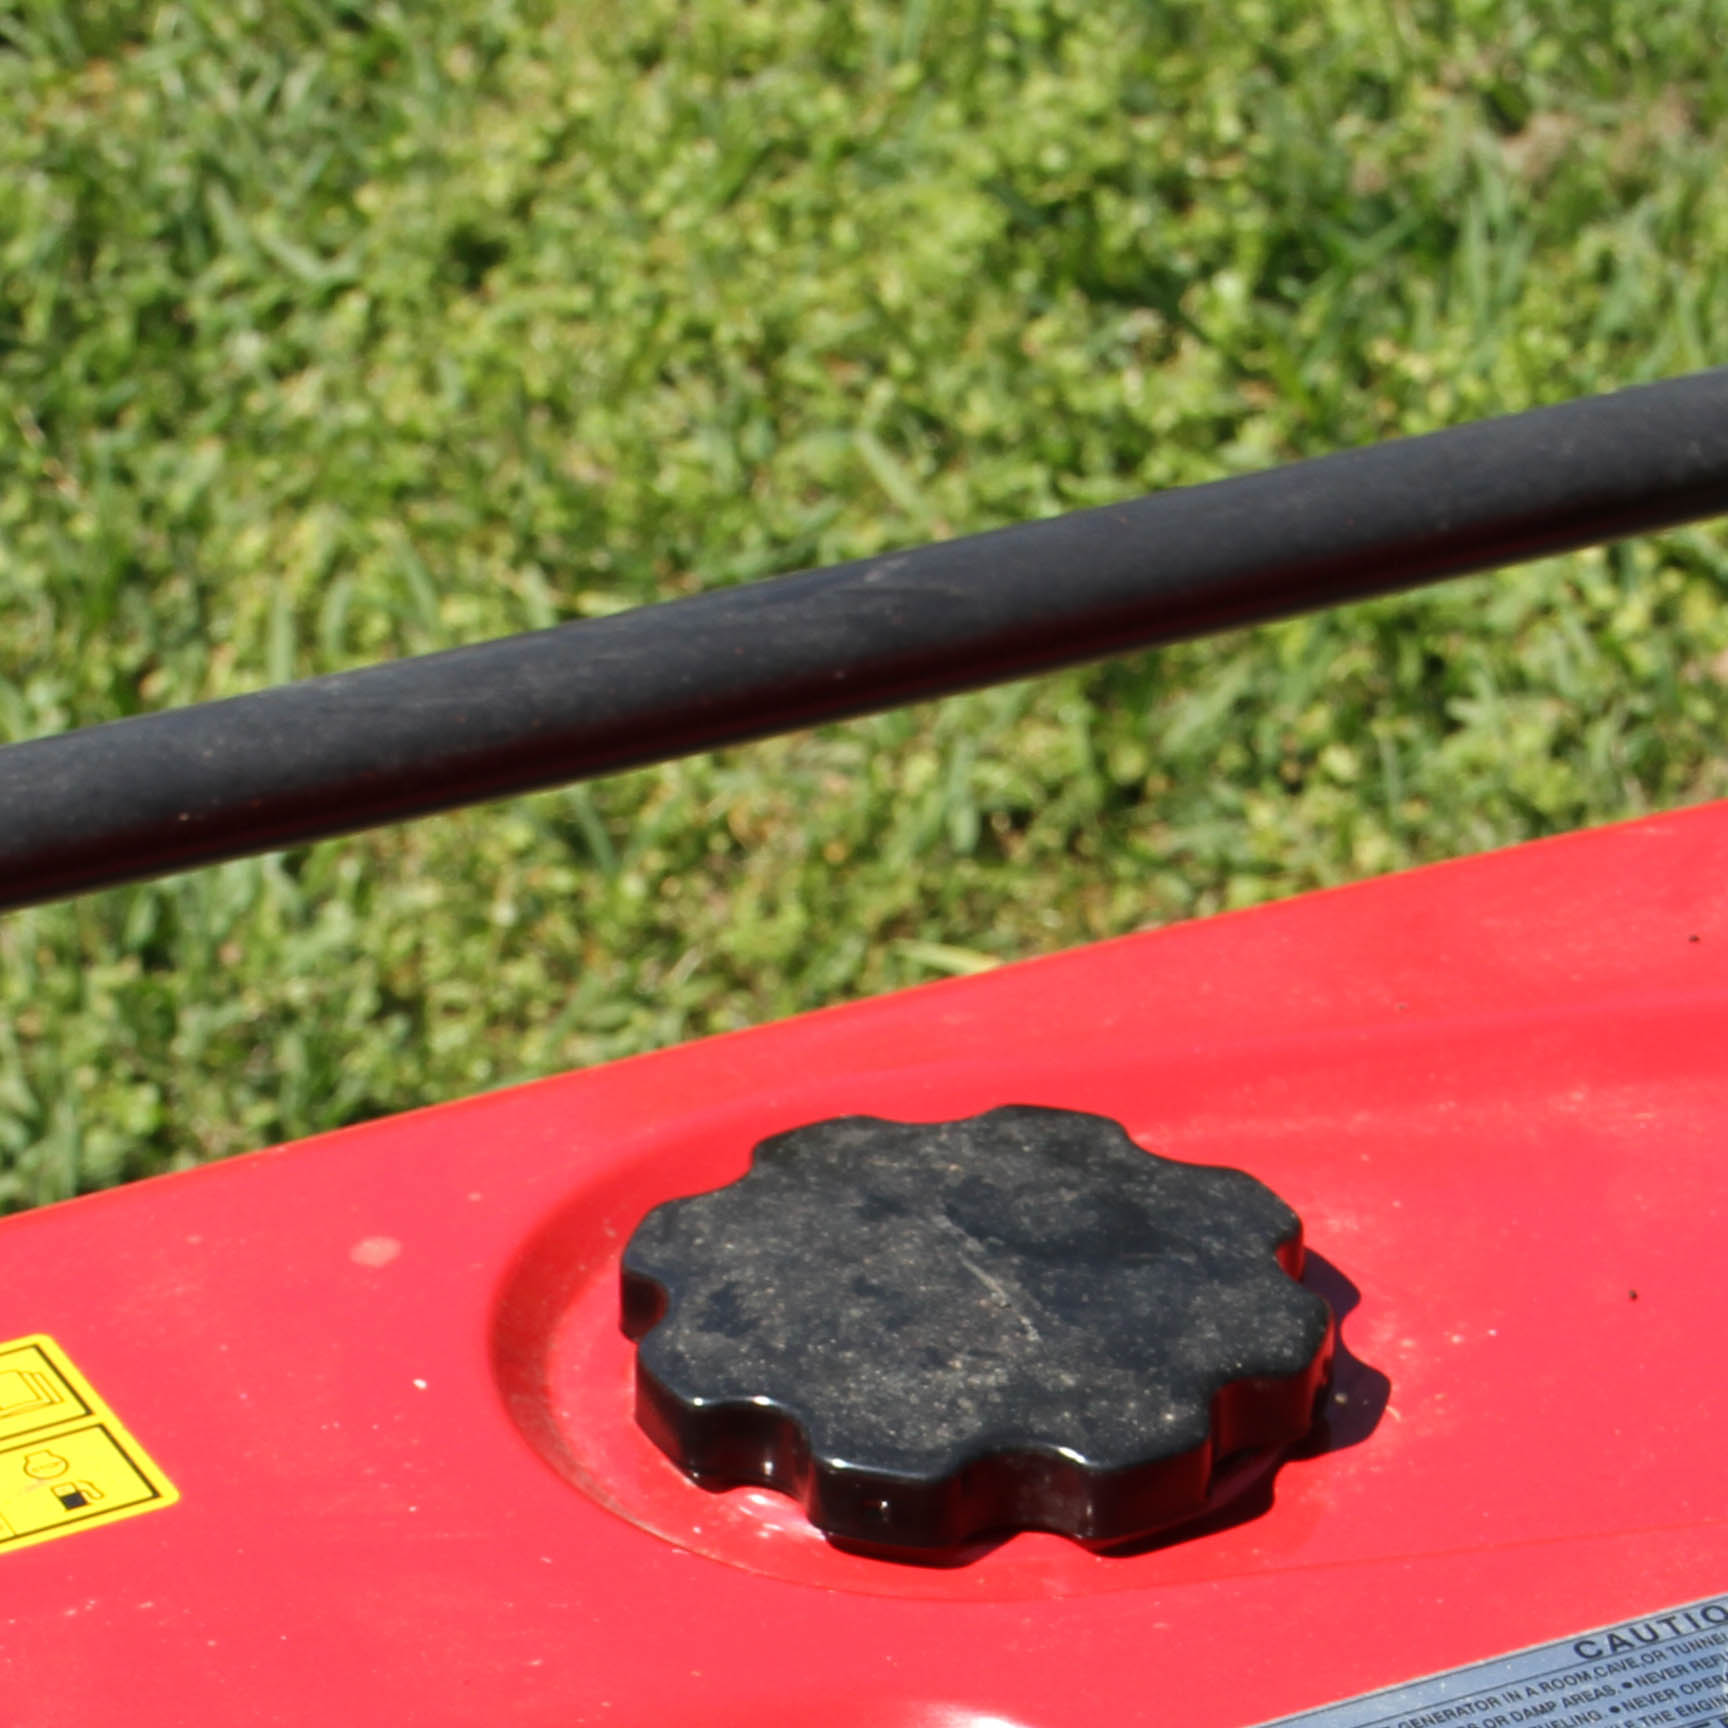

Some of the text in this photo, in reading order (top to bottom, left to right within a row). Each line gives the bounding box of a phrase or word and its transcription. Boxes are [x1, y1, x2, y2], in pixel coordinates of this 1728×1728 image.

[1500, 1689, 1524, 1704] IN
[1524, 1685, 1541, 1699] A
[1620, 1687, 1680, 1712] NEVER
[1636, 1709, 1677, 1728] THE
